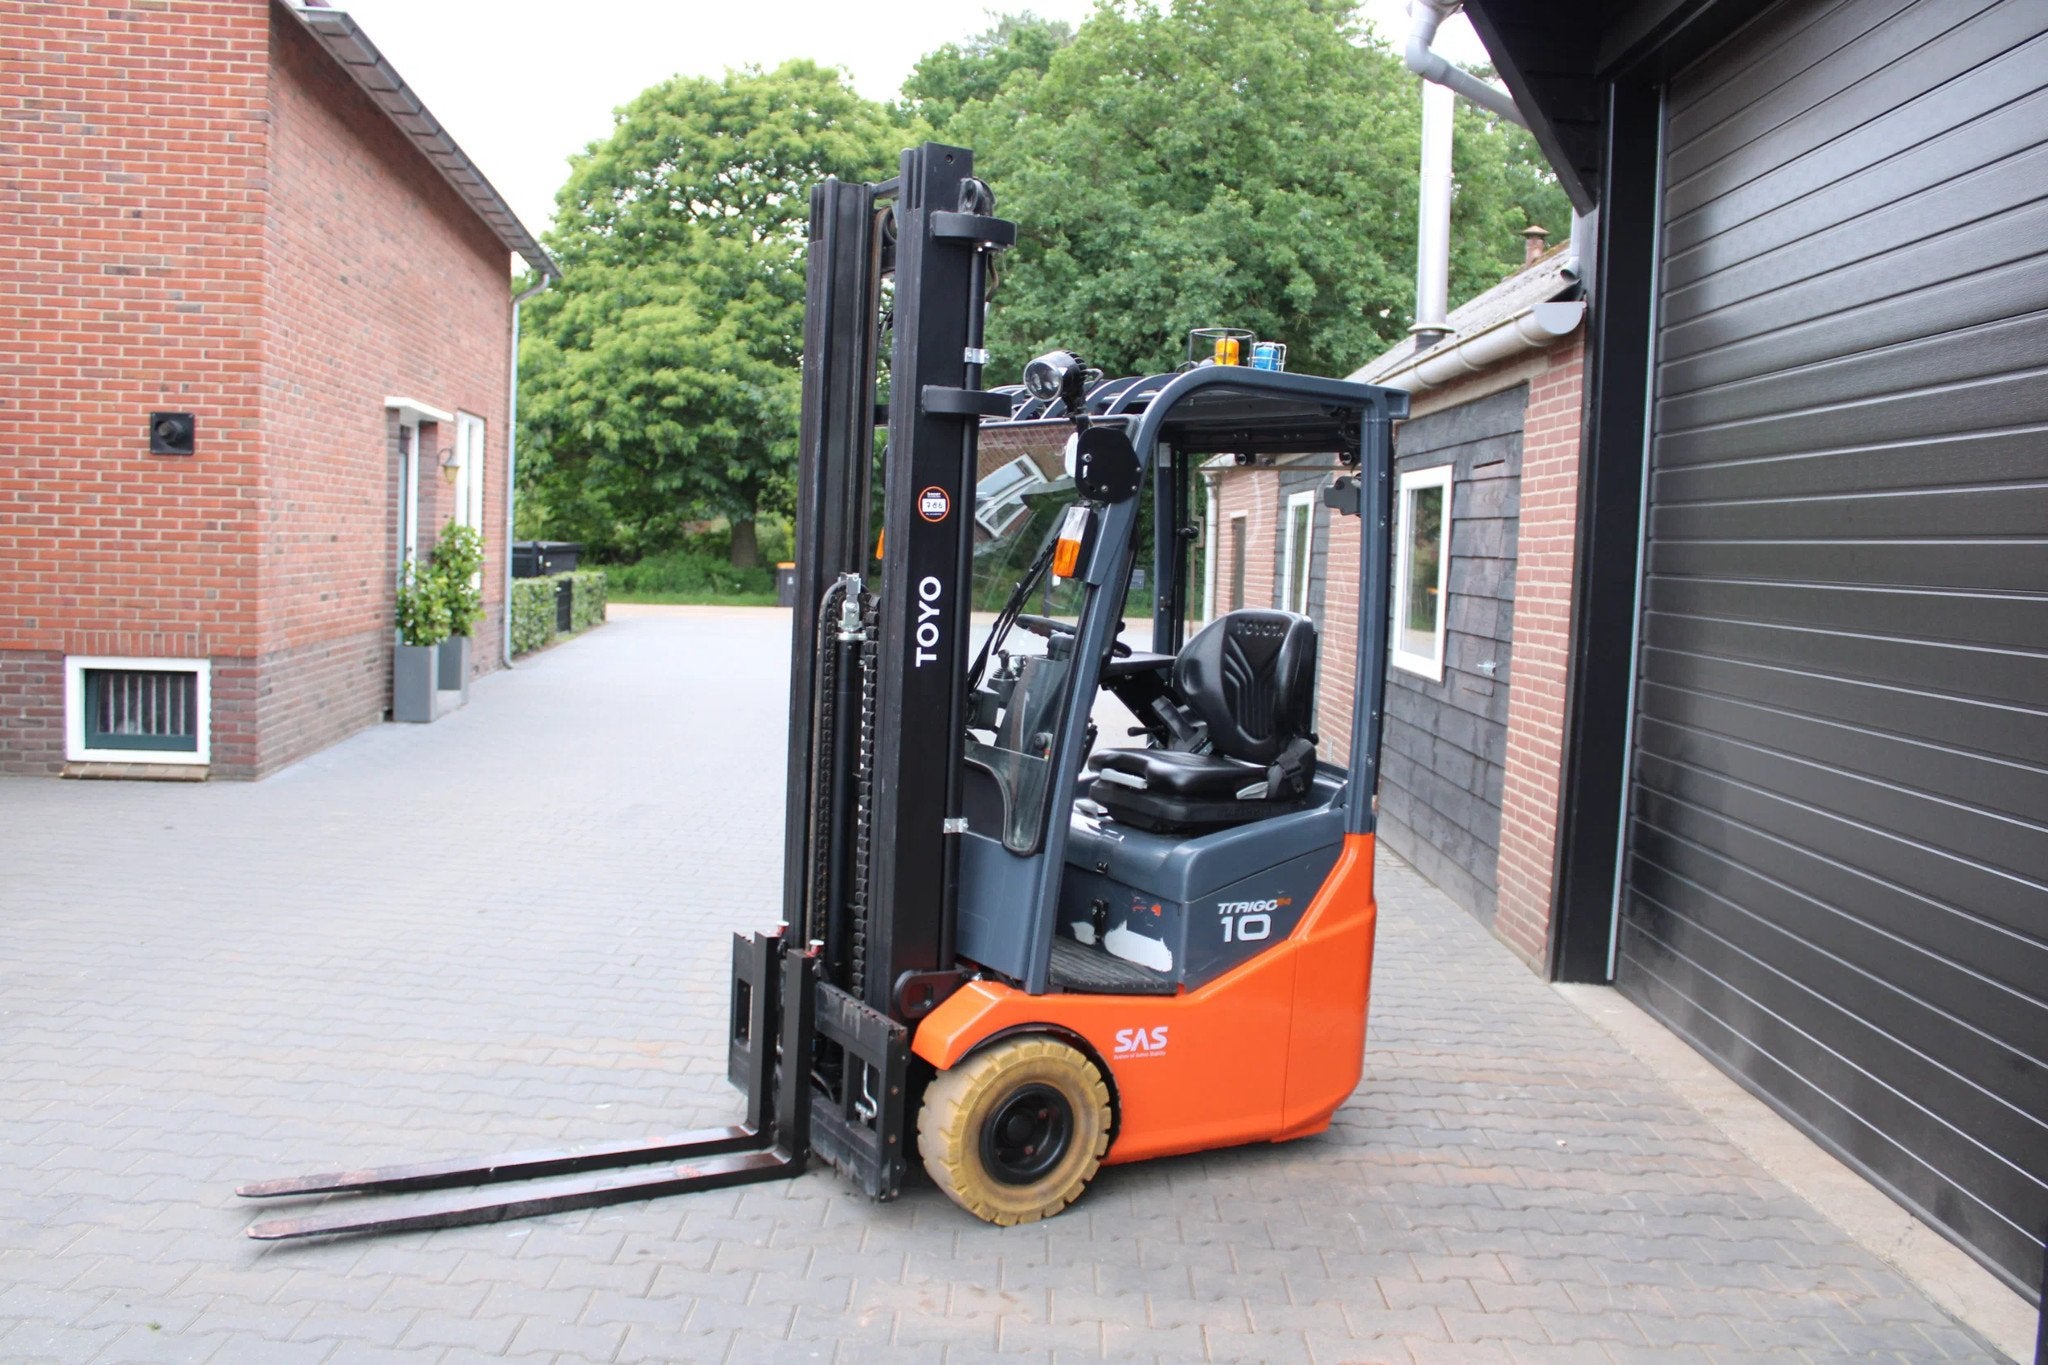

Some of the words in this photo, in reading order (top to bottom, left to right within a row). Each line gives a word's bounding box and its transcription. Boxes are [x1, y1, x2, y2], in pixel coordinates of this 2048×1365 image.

[915, 576, 941, 667] TOYO
[1221, 914, 1271, 942] 10
[1114, 1026, 1168, 1053] SAS
